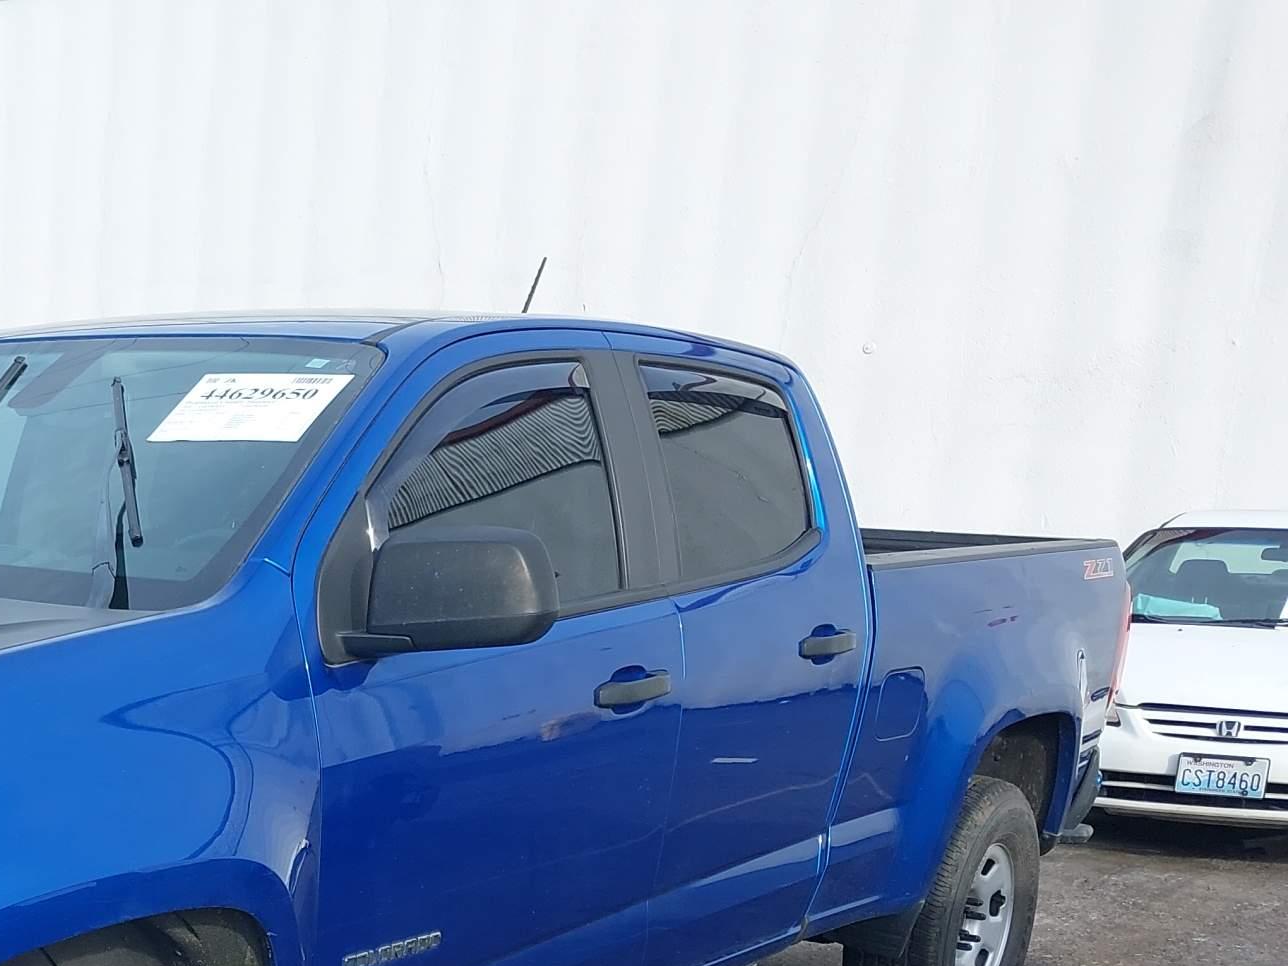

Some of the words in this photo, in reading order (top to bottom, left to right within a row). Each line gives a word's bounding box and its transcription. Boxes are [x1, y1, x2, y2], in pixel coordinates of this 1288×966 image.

[200, 387, 319, 400] 44629650
[1083, 557, 1114, 580] Z71
[1186, 760, 1235, 770] WASHINGTON
[1181, 769, 1261, 792] CST8460
